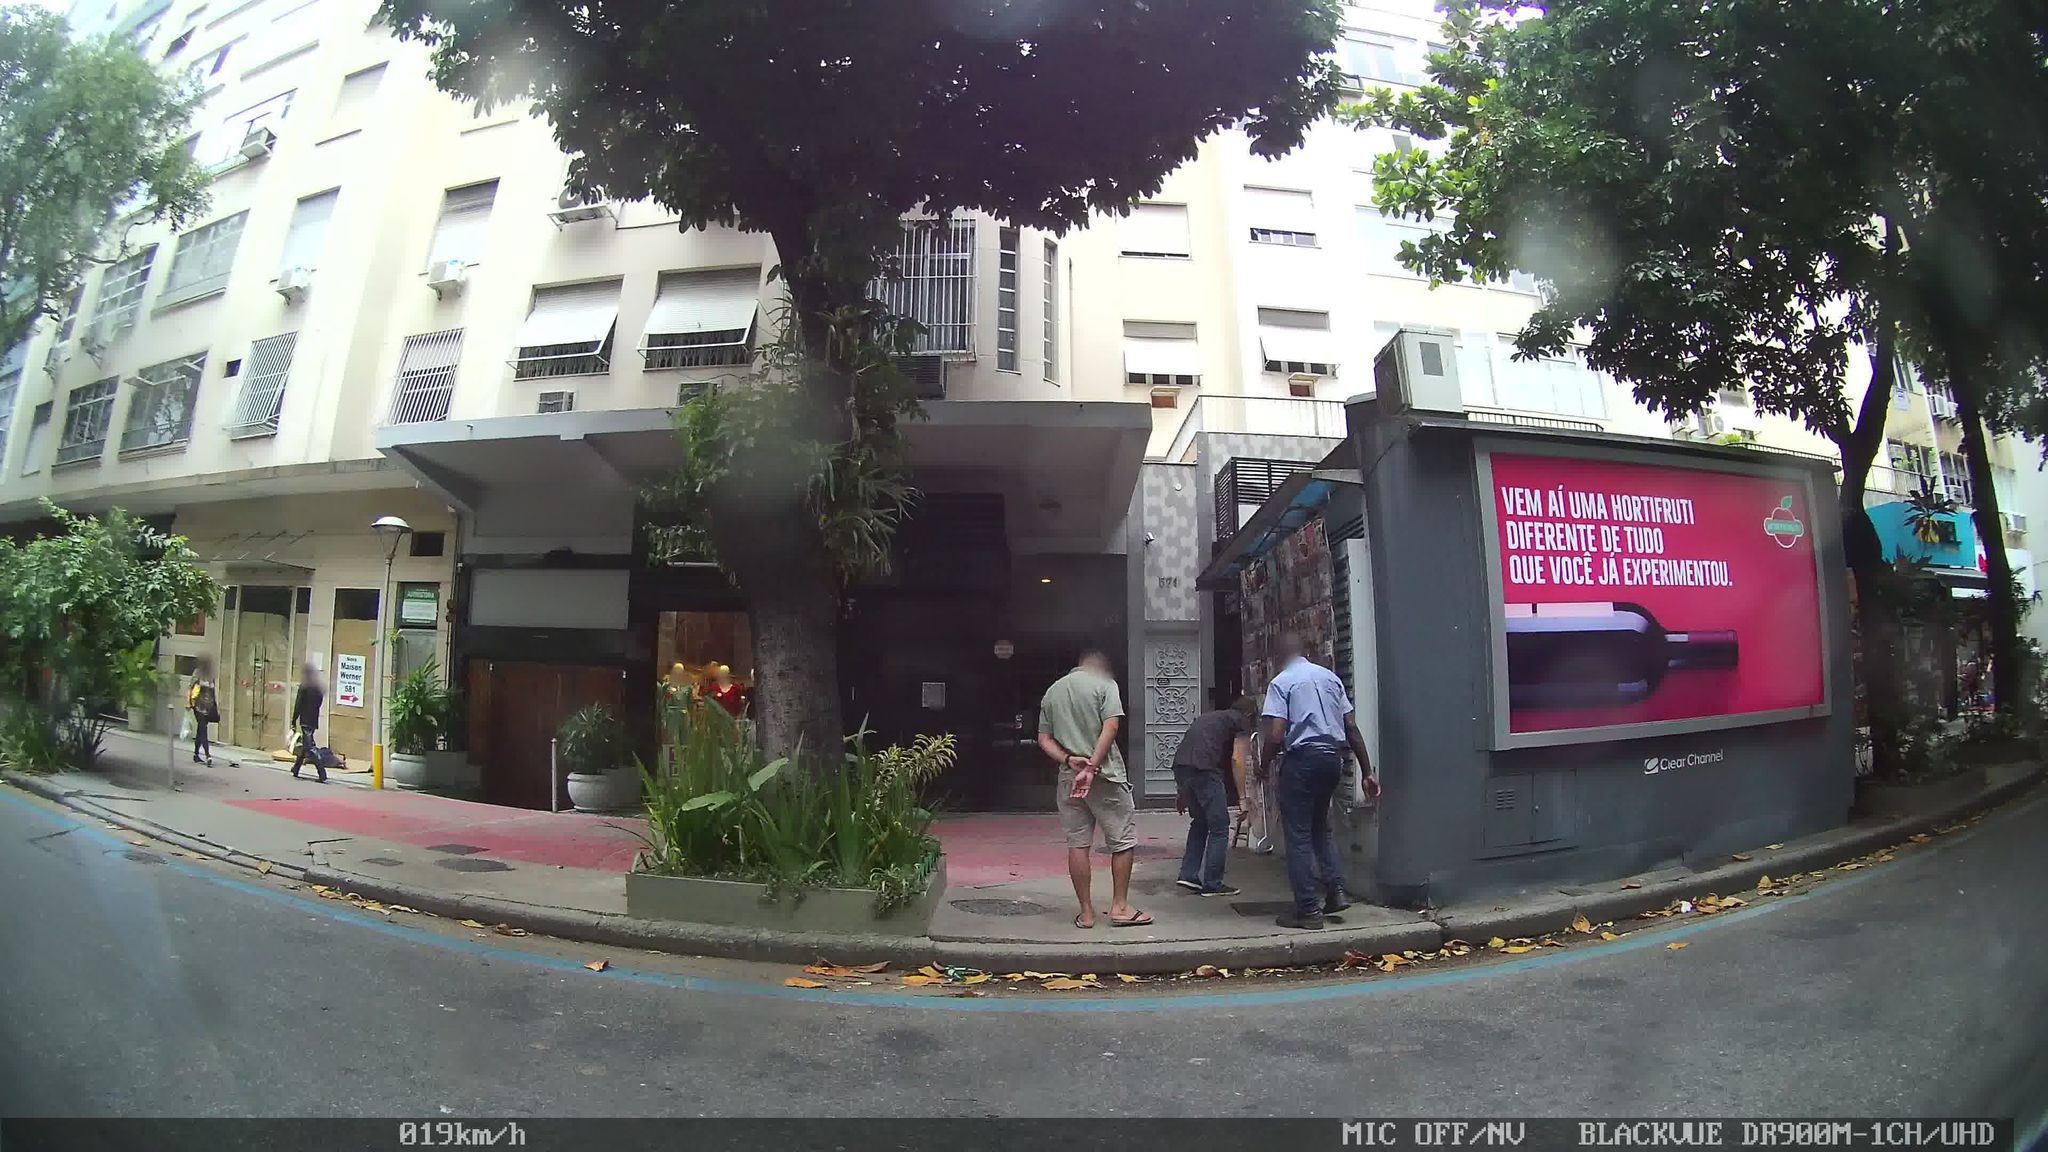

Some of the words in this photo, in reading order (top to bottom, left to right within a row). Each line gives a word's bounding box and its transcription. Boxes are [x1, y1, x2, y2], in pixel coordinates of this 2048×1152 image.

[1501, 486, 1543, 517] VEM
[1548, 484, 1566, 518] AÍ
[1568, 491, 1608, 520] UMA
[1610, 494, 1695, 525] HORTIFRUTI
[1505, 520, 1597, 552] DIFERENTE
[1600, 525, 1622, 553] DE
[1623, 526, 1664, 554] TUDO
[1509, 555, 1546, 584] QUE
[1549, 551, 1595, 585] VOCÊ
[1598, 552, 1620, 585] JÁ
[1622, 558, 1733, 587] EXPERIMENTOU.
[340, 662, 362, 671] Maison
[340, 671, 362, 681] Werner
[344, 685, 356, 693] 581
[1660, 757, 1686, 771] Clear
[1687, 748, 1724, 766] Channel
